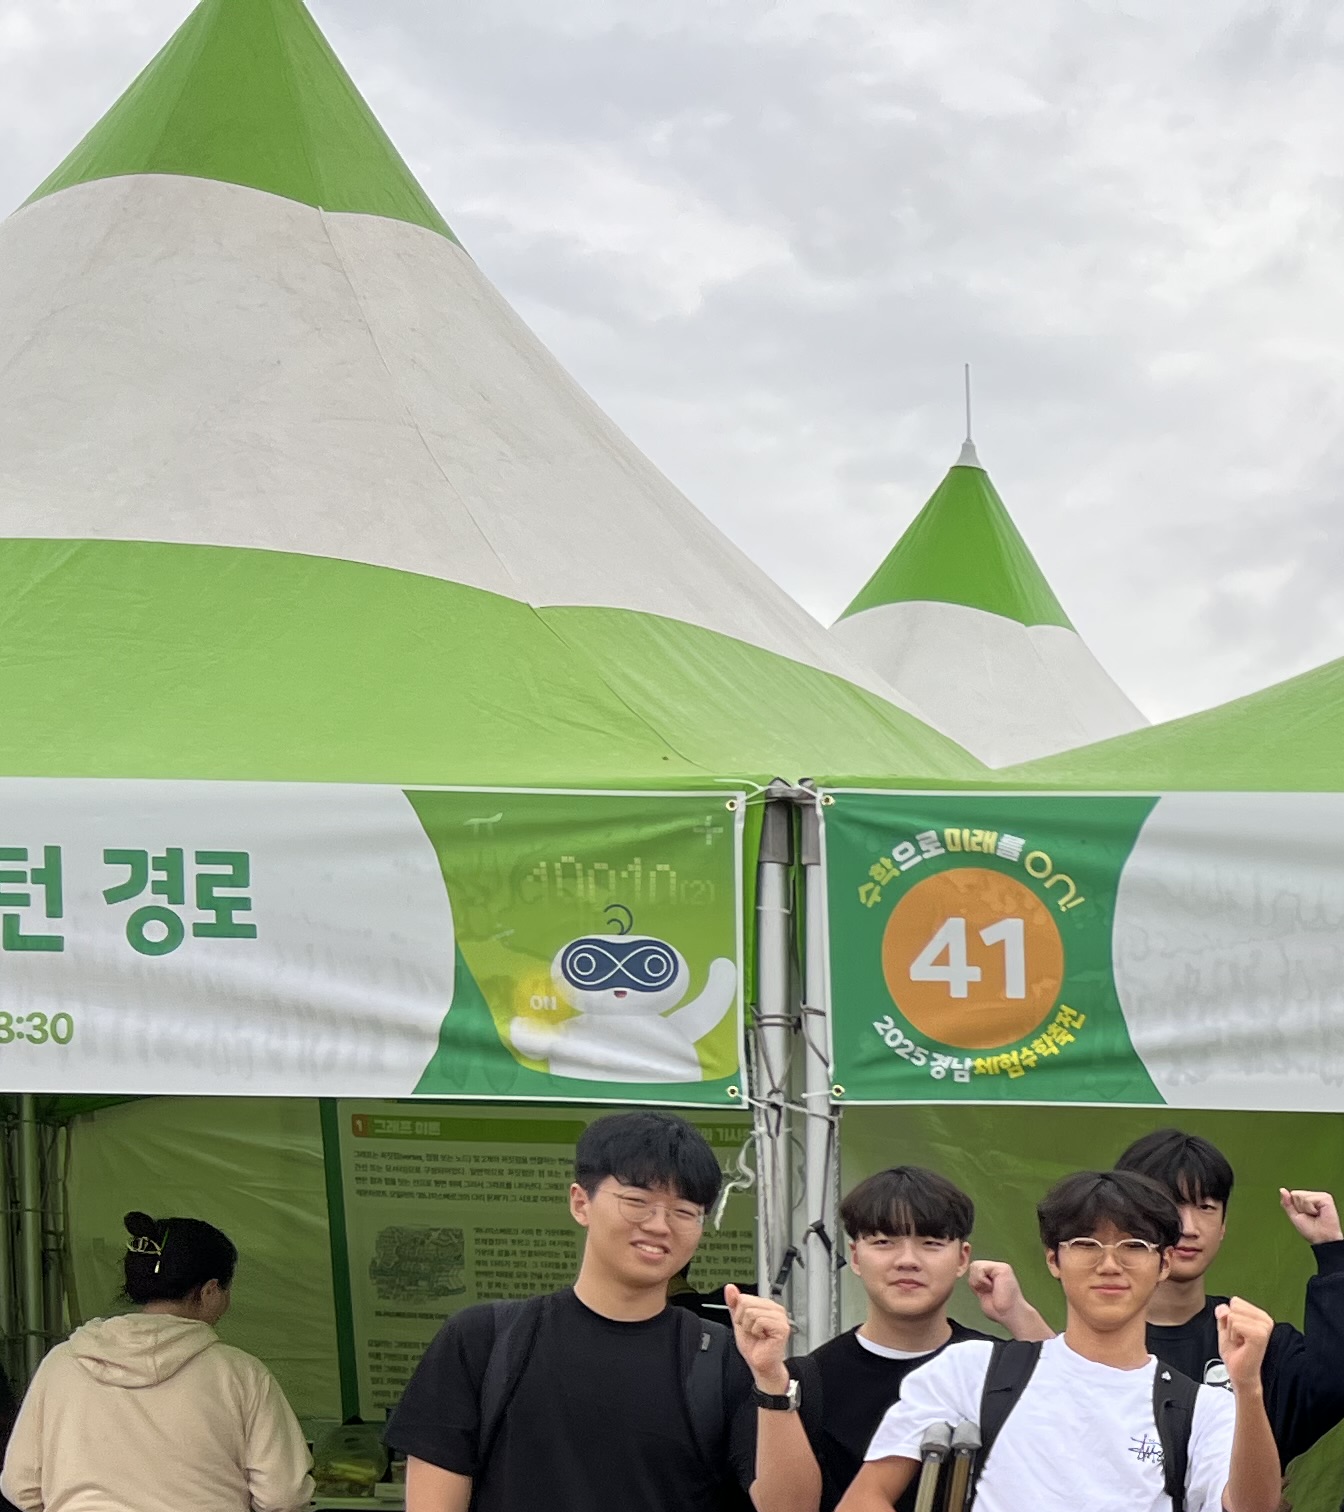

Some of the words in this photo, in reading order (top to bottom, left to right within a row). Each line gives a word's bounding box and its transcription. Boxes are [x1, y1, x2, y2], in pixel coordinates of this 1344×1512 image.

[102, 847, 258, 957] 경로
[909, 917, 1026, 999] 41
[872, 1014, 929, 1067] 2025
